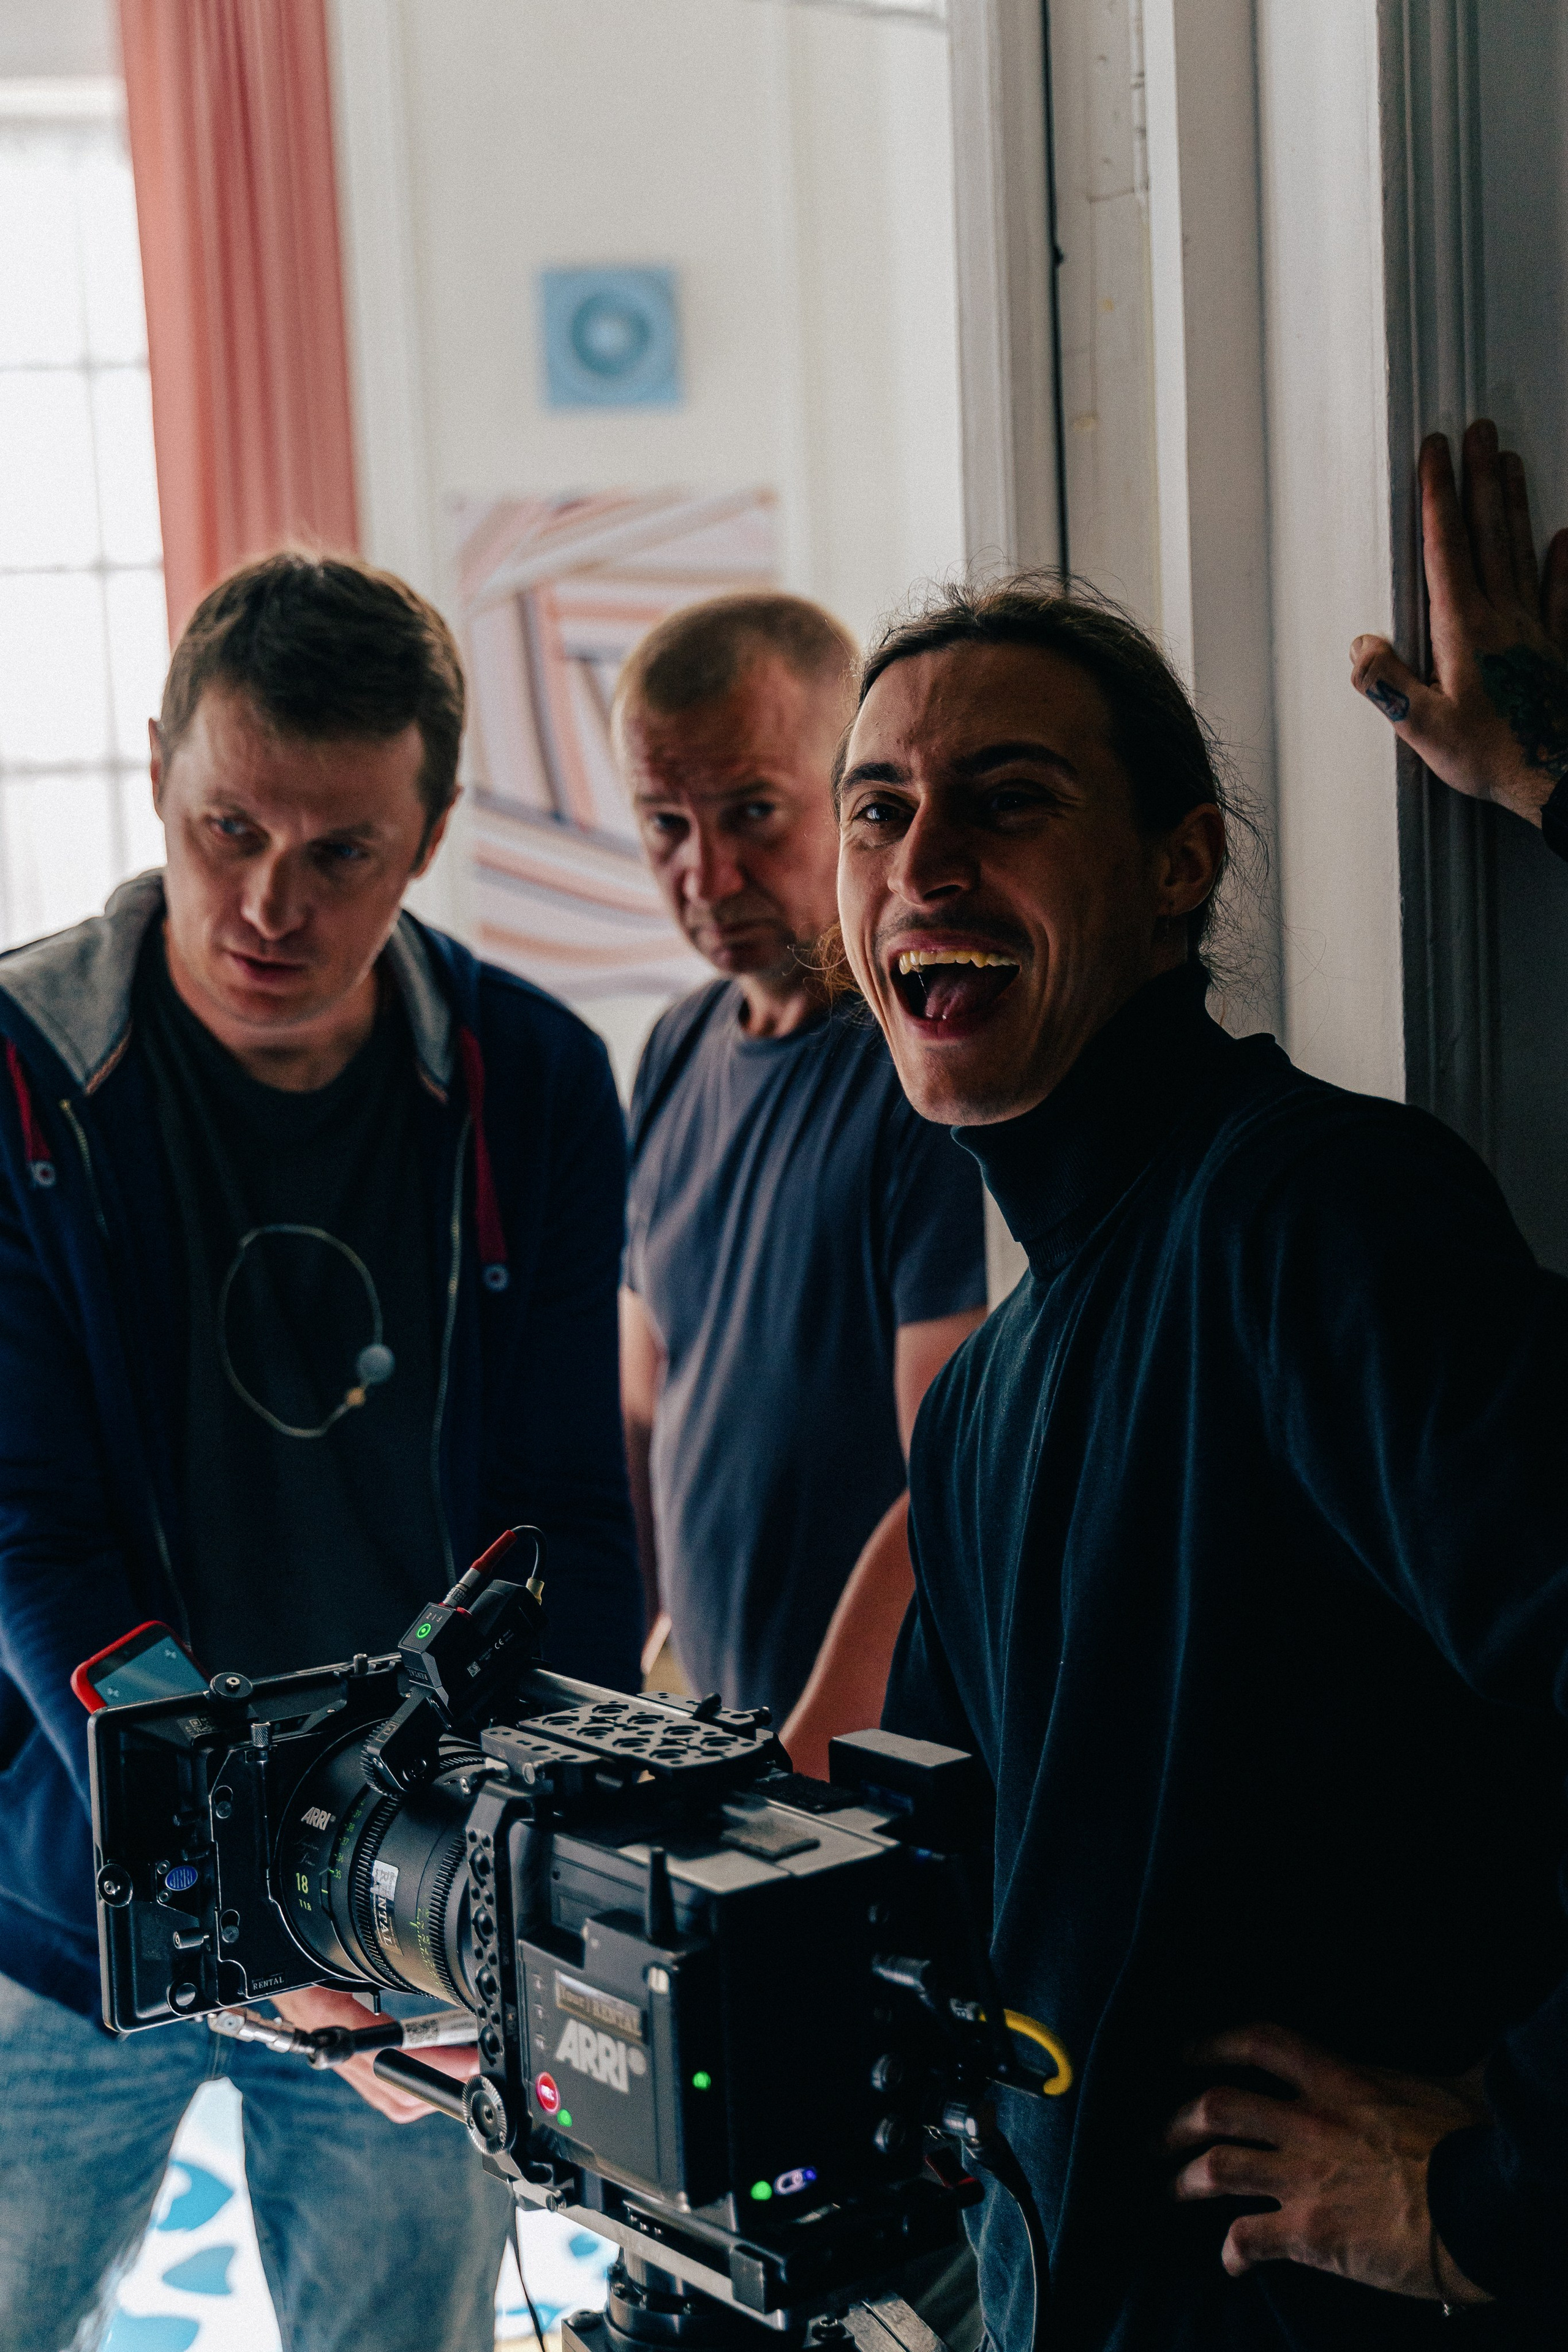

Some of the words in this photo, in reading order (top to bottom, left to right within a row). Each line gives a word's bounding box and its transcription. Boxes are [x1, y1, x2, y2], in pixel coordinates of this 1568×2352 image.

[407, 1668, 429, 1681] RENTAL
[301, 1807, 331, 1831] ARRI
[170, 1868, 193, 1888] ARRI
[296, 1872, 309, 1894] 18
[253, 1977, 284, 1990] RENTAL
[556, 2018, 630, 2095] ARRI
